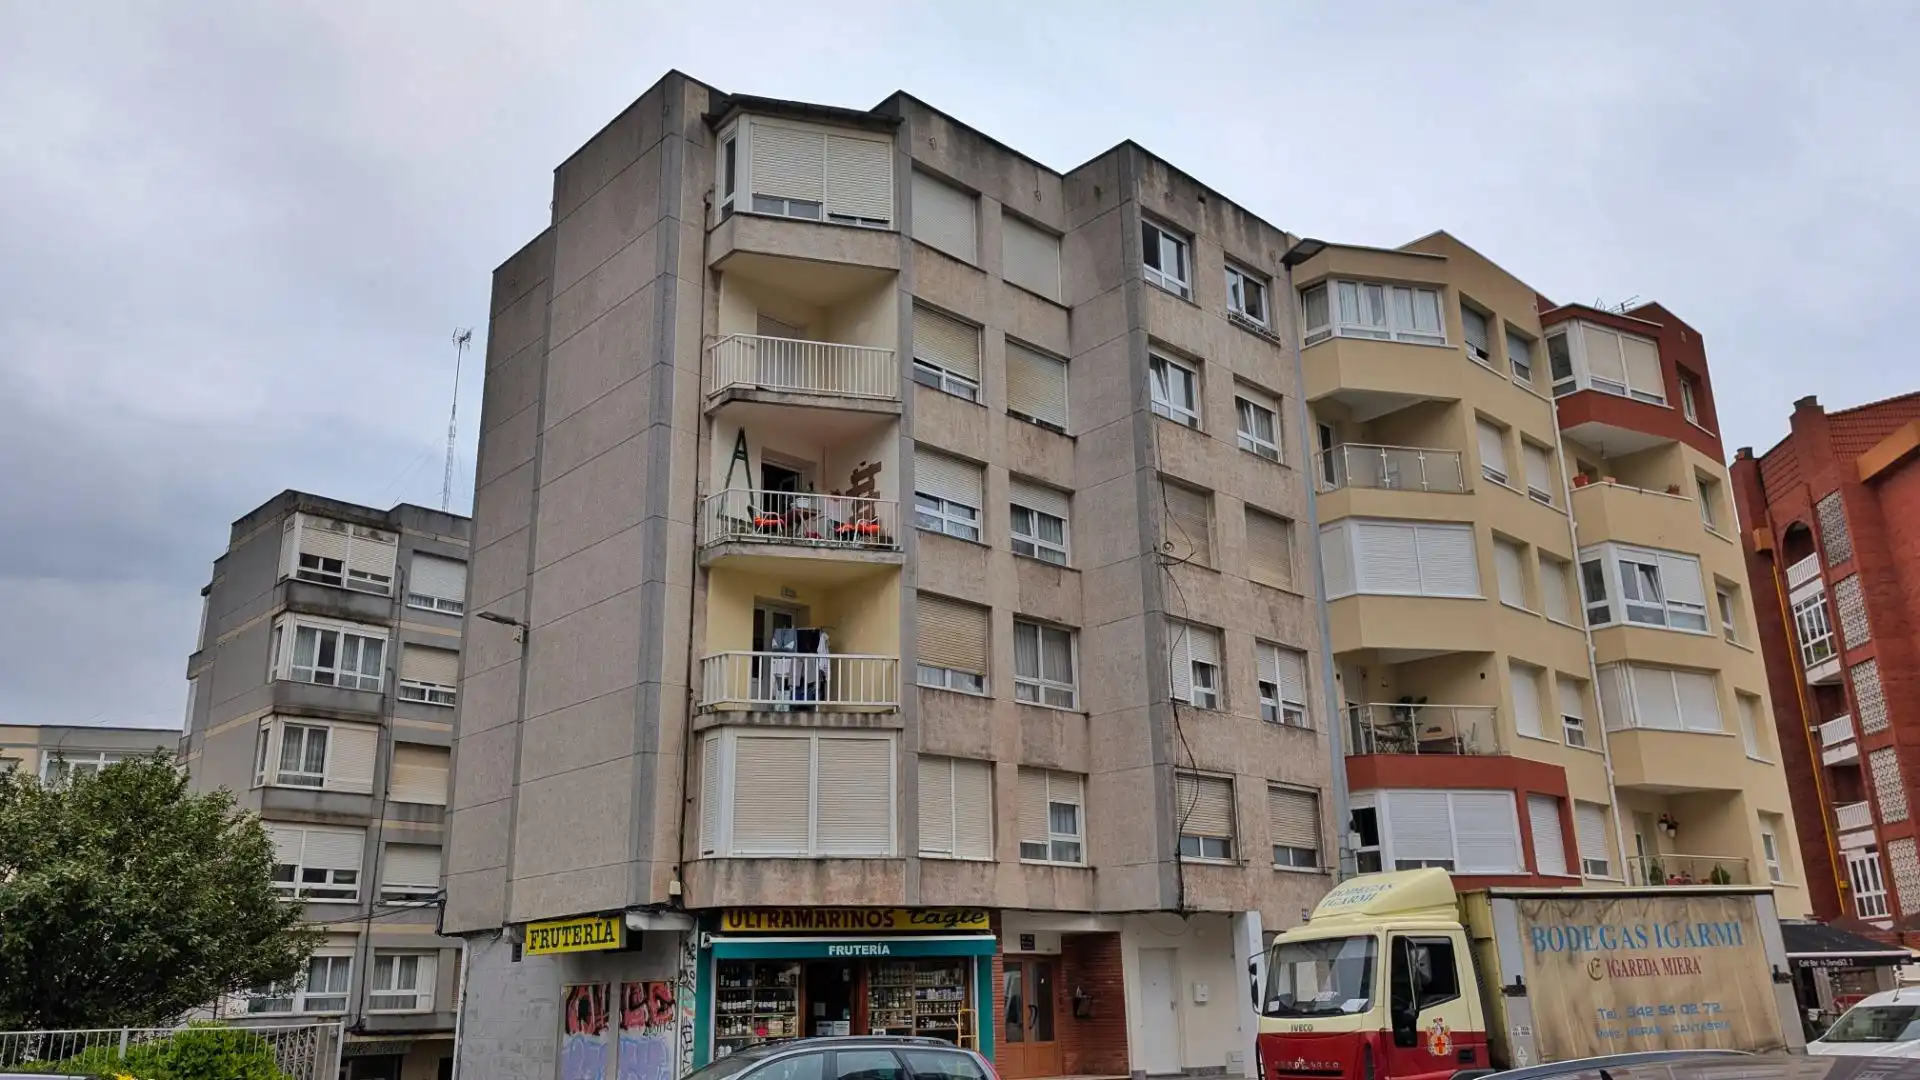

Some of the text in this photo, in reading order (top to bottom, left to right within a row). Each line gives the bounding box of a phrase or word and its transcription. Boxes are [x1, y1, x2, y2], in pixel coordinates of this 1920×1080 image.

[728, 908, 894, 929] ULTRAMARINOS
[1531, 920, 1744, 953] BODEGAS IGARMI
[828, 943, 890, 956] FRUTERÍA
[1606, 957, 1660, 979] IGAREDA
[1661, 955, 1702, 976] MIERA
[1626, 1005, 1654, 1018] 942
[1702, 1001, 1722, 1014] 72
[1290, 1023, 1313, 1033] IVECO
